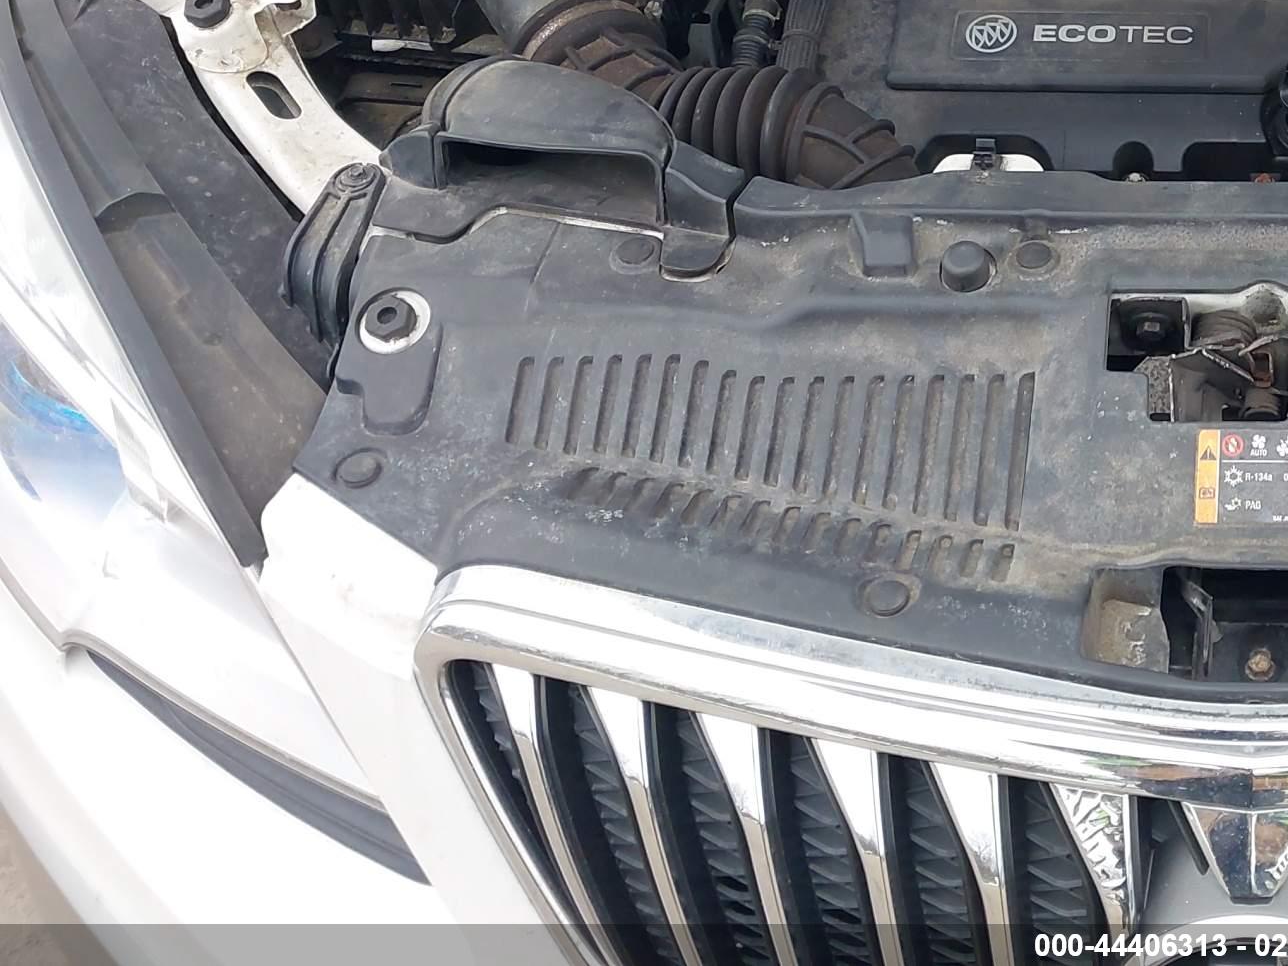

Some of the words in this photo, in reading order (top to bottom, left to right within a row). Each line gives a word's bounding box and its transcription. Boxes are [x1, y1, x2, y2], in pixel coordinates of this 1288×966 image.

[1032, 23, 1194, 44] ECOTEC
[1250, 448, 1267, 457] AUTO
[1245, 472, 1273, 482] R-134a
[1245, 500, 1262, 510] PAG
